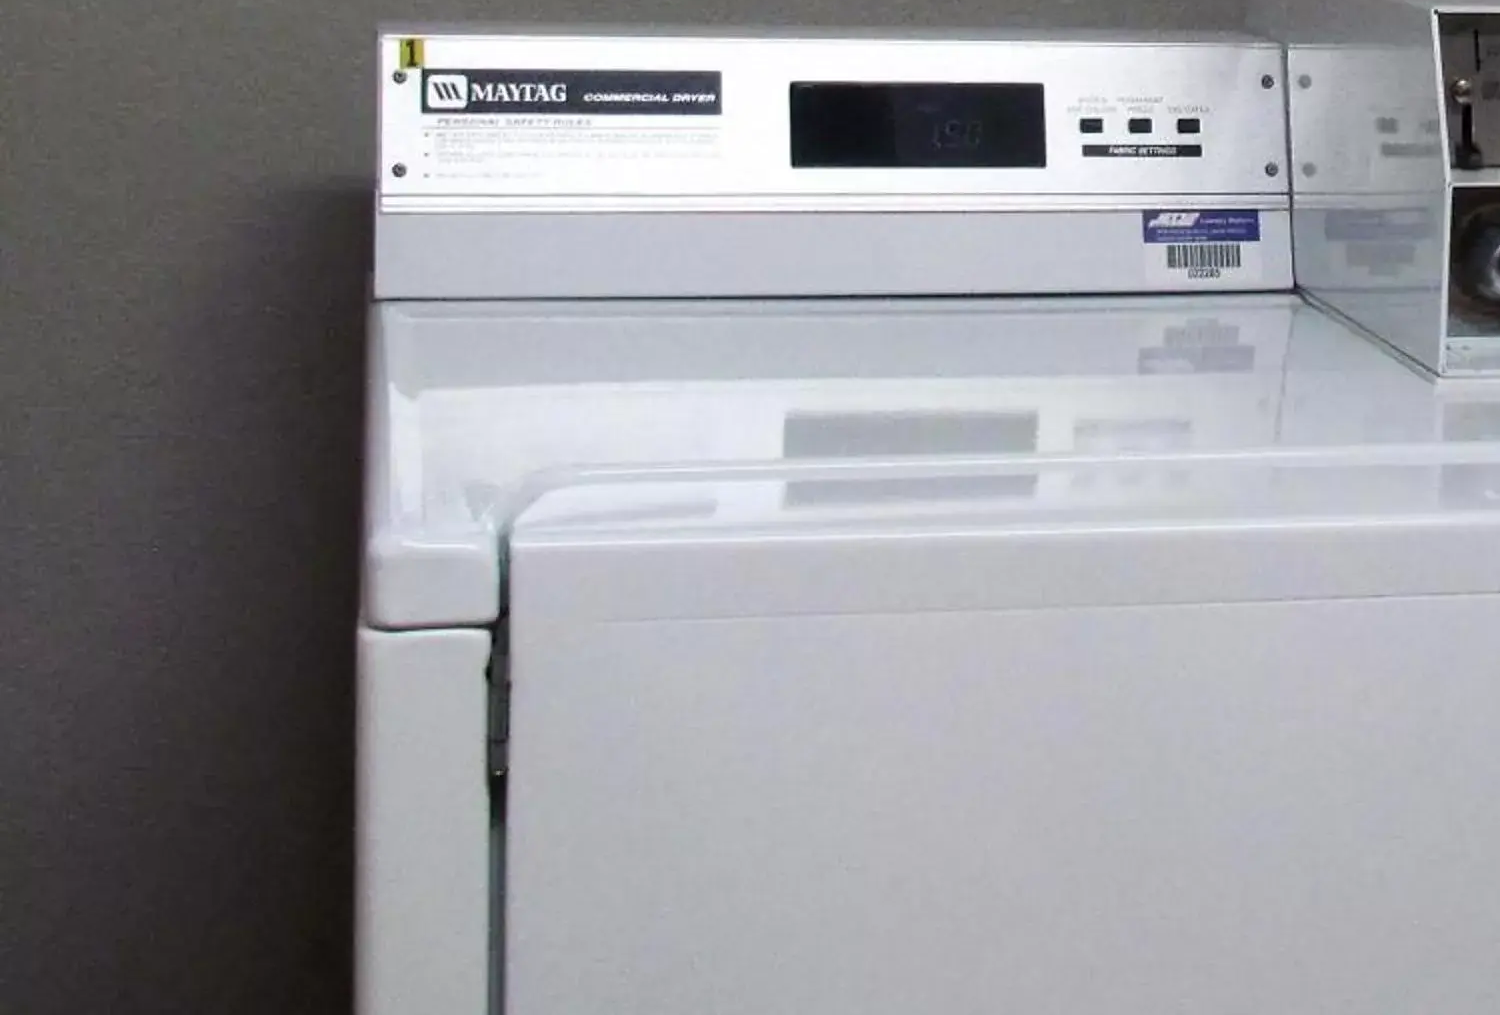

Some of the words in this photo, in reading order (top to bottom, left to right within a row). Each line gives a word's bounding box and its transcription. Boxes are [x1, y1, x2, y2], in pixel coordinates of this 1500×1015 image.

[406, 39, 417, 67] 1
[471, 82, 568, 103] MAYTAG
[582, 91, 670, 103] COMMERCIAL
[671, 92, 717, 103] DRYER
